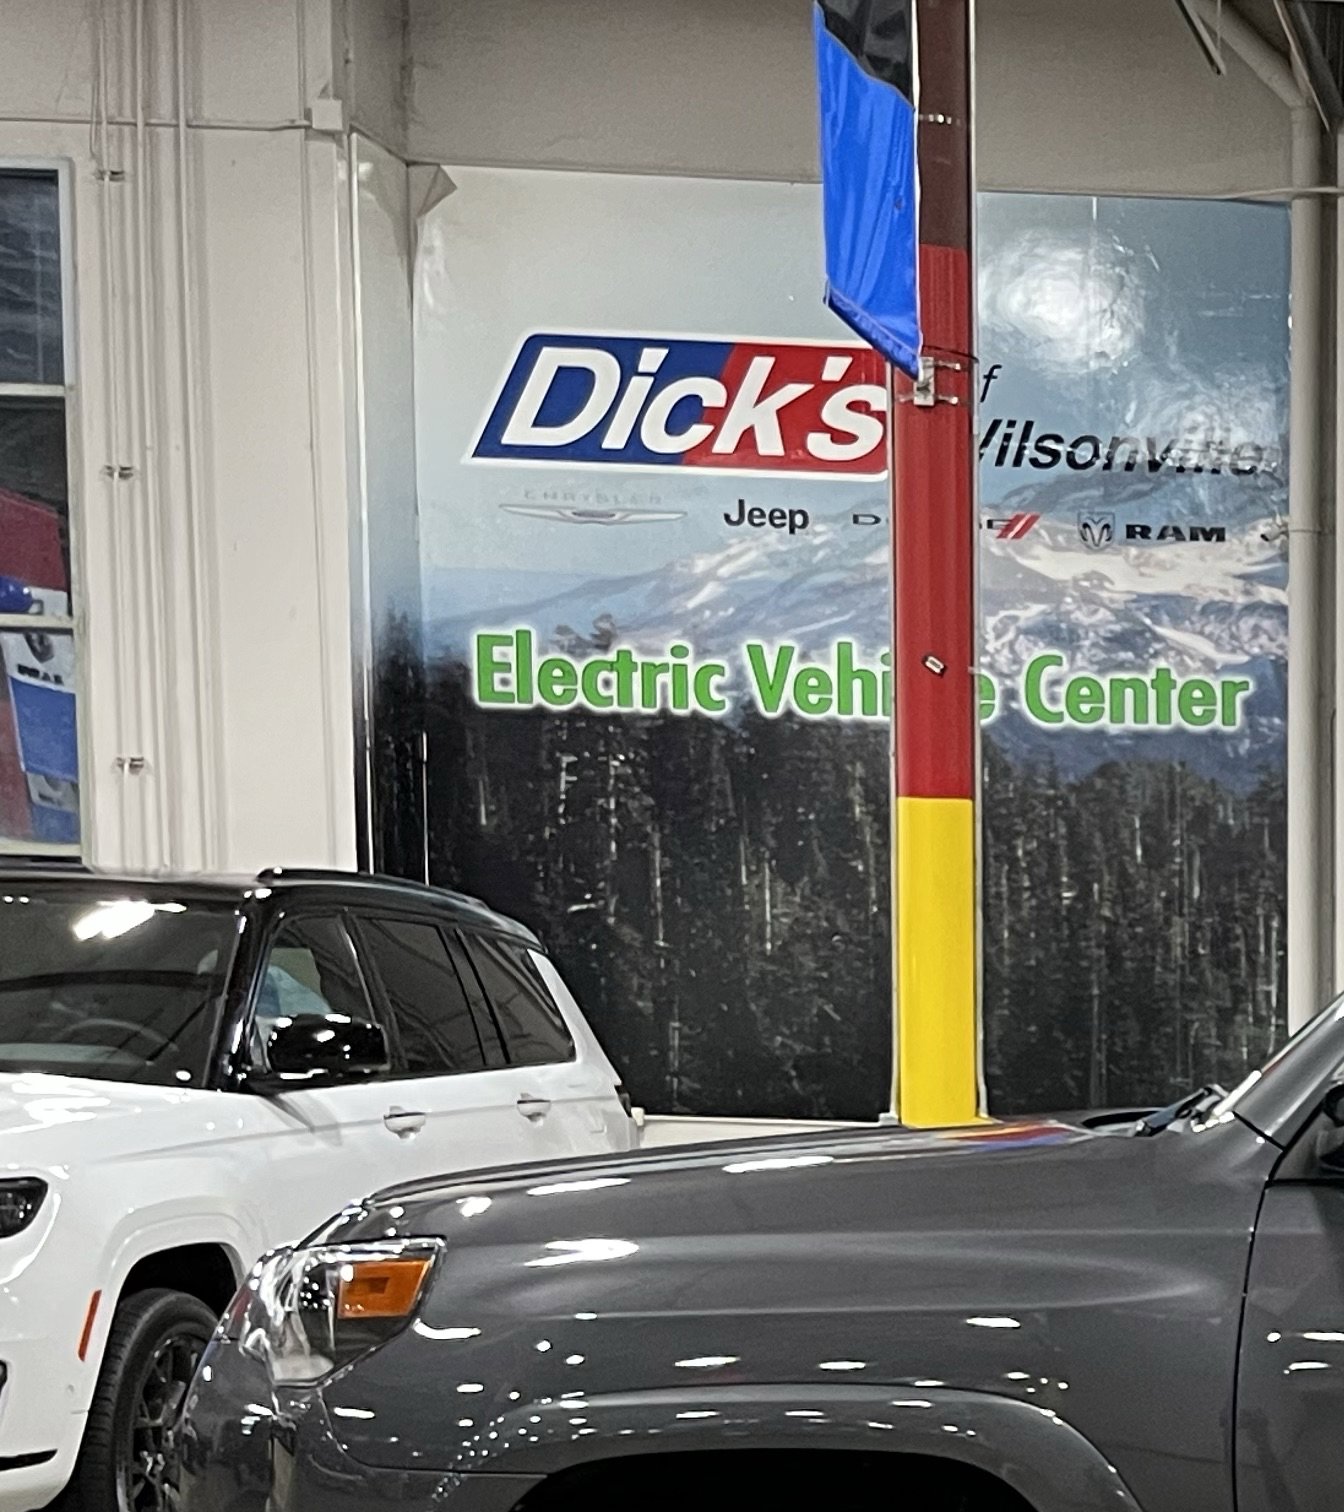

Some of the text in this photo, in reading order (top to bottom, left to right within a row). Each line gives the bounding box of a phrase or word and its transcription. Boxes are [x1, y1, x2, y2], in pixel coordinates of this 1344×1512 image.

[500, 346, 887, 461] Dick's
[979, 364, 1003, 402] f
[979, 418, 1263, 475] ilsonville
[723, 499, 809, 535] Jeep
[1125, 524, 1226, 542] RAM
[476, 630, 726, 712] Electric
[1025, 654, 1250, 726] Center
